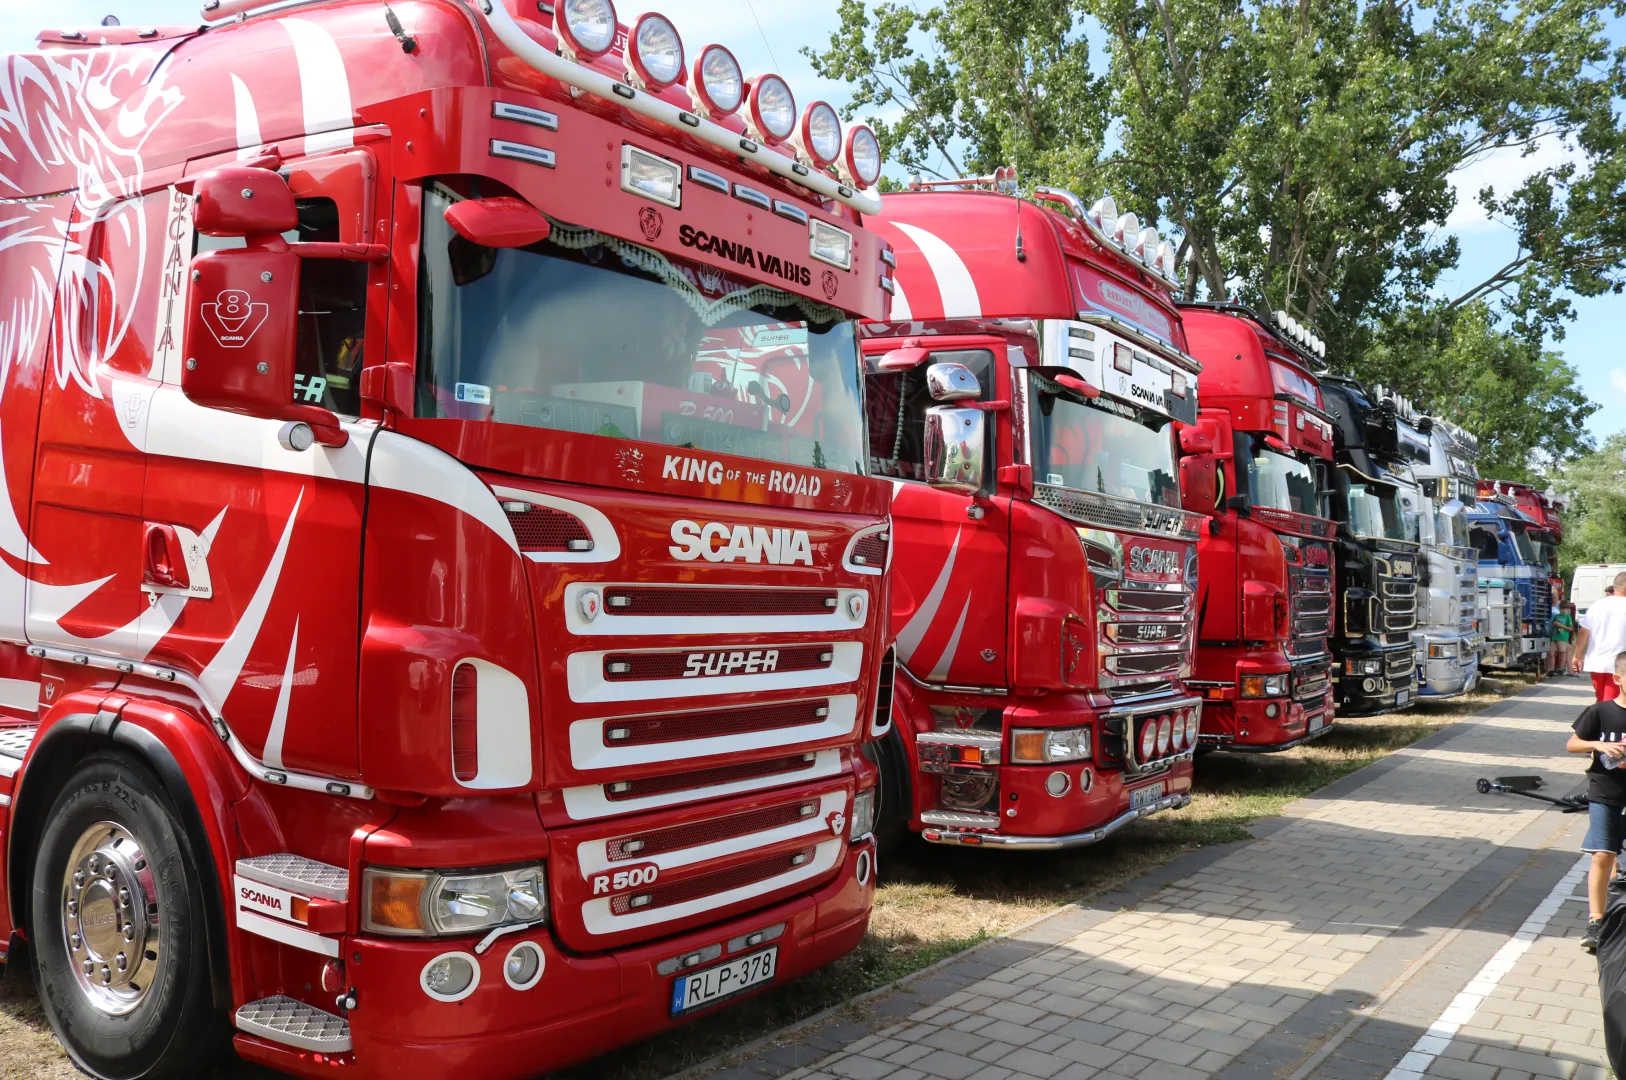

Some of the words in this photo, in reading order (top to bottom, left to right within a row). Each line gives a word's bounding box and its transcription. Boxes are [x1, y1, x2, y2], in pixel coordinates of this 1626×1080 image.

[679, 223, 757, 270] SCANIA
[756, 250, 812, 287] VABIS
[157, 190, 188, 352] SCANIA
[1131, 383, 1156, 405] SCANIA
[662, 454, 724, 486] KING
[726, 468, 741, 481] OF
[745, 471, 766, 485] THE
[767, 469, 822, 498] ROAD
[669, 519, 814, 566] SCANIA
[1130, 545, 1181, 575] SCANIA
[190, 585, 209, 593] SCANIA
[1136, 625, 1168, 639] SUPER
[683, 649, 780, 677] SUPER
[593, 875, 610, 895] R
[613, 865, 658, 890] 500
[240, 887, 282, 911] SCANIA
[675, 996, 682, 1008] H
[688, 952, 772, 1004] RLP-378
